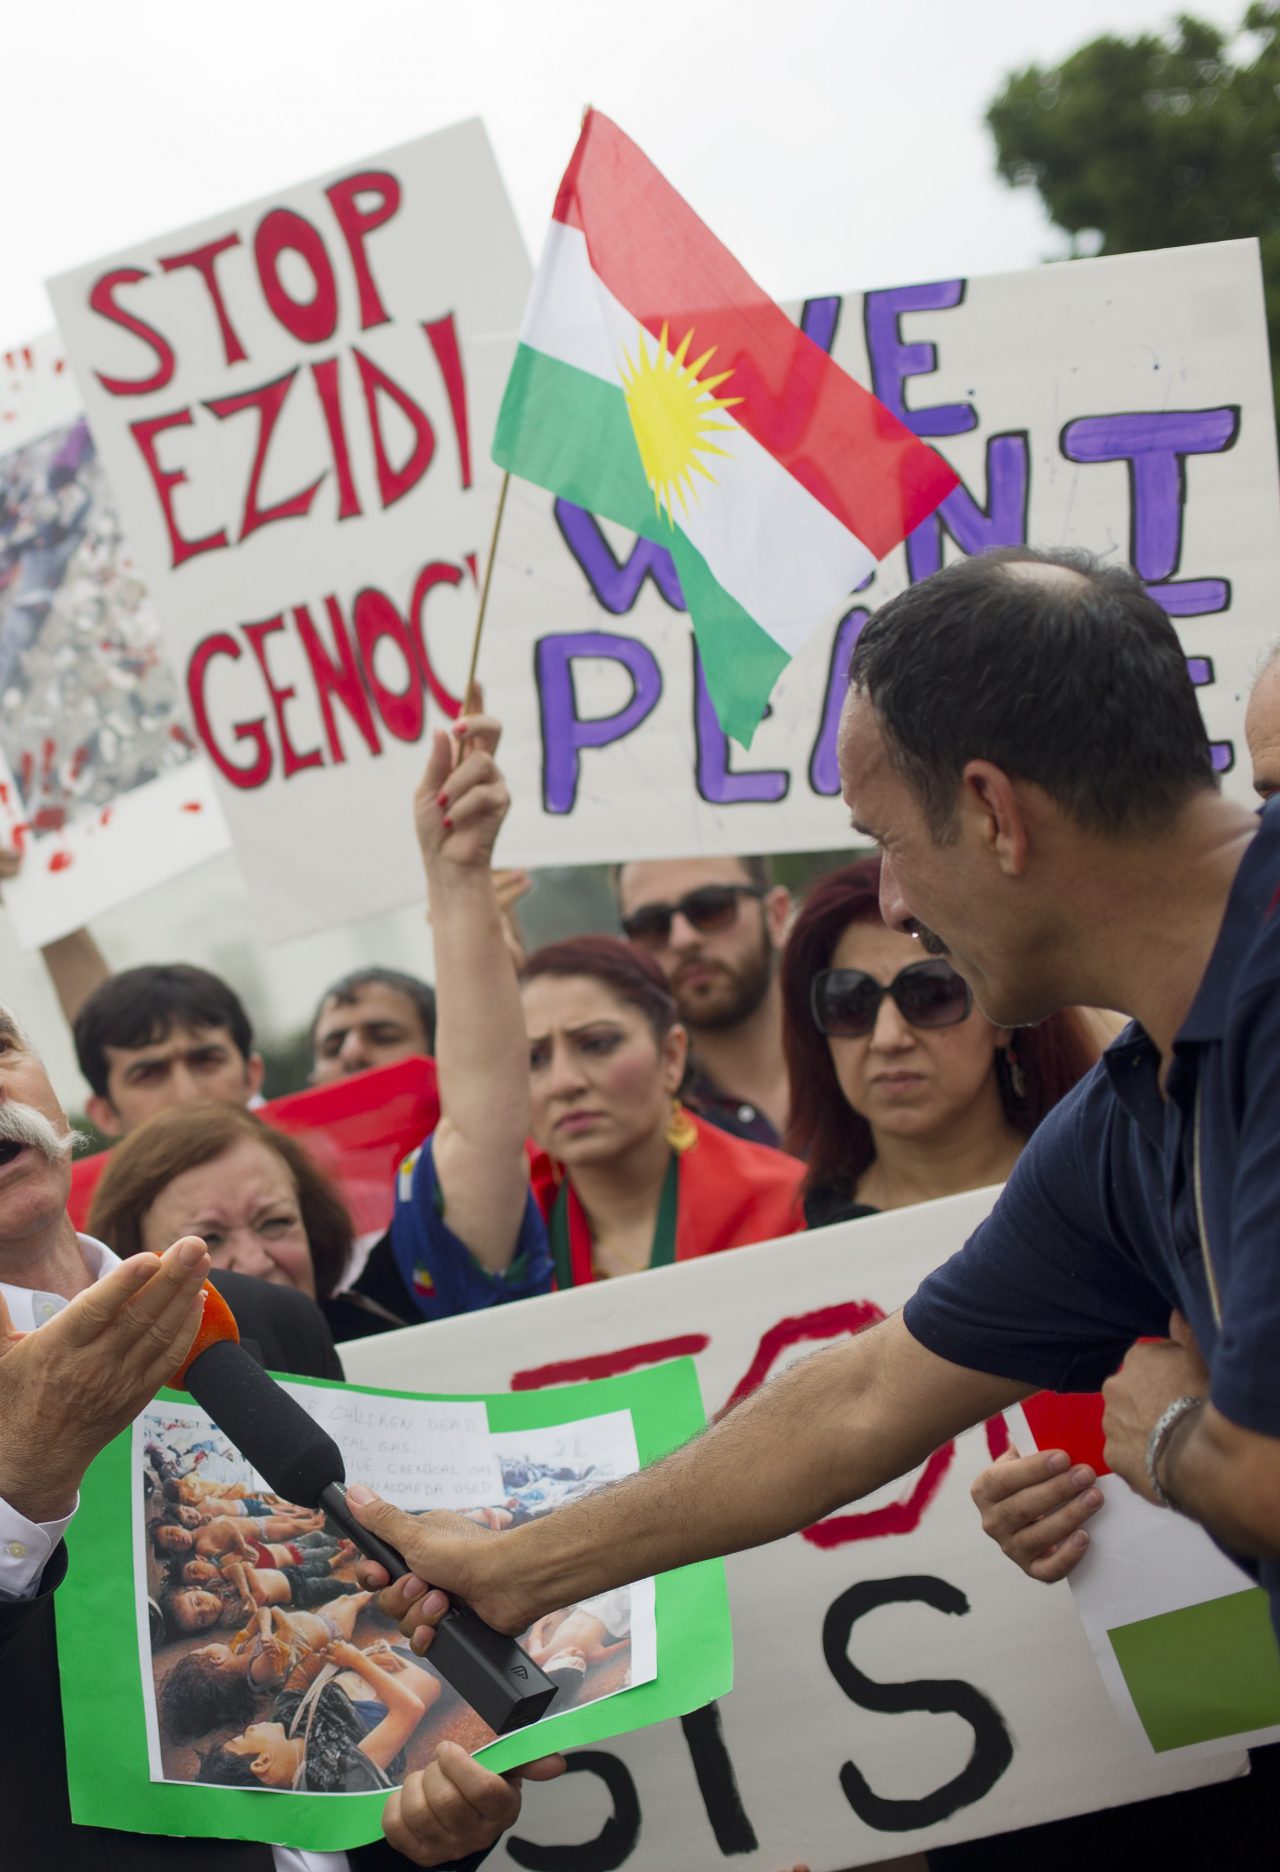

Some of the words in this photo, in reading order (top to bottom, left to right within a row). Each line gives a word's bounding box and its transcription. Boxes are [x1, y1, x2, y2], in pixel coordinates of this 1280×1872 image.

[89, 170, 402, 398] STOP
[129, 311, 473, 570] EZIDI
[186, 550, 479, 790] GENOC
